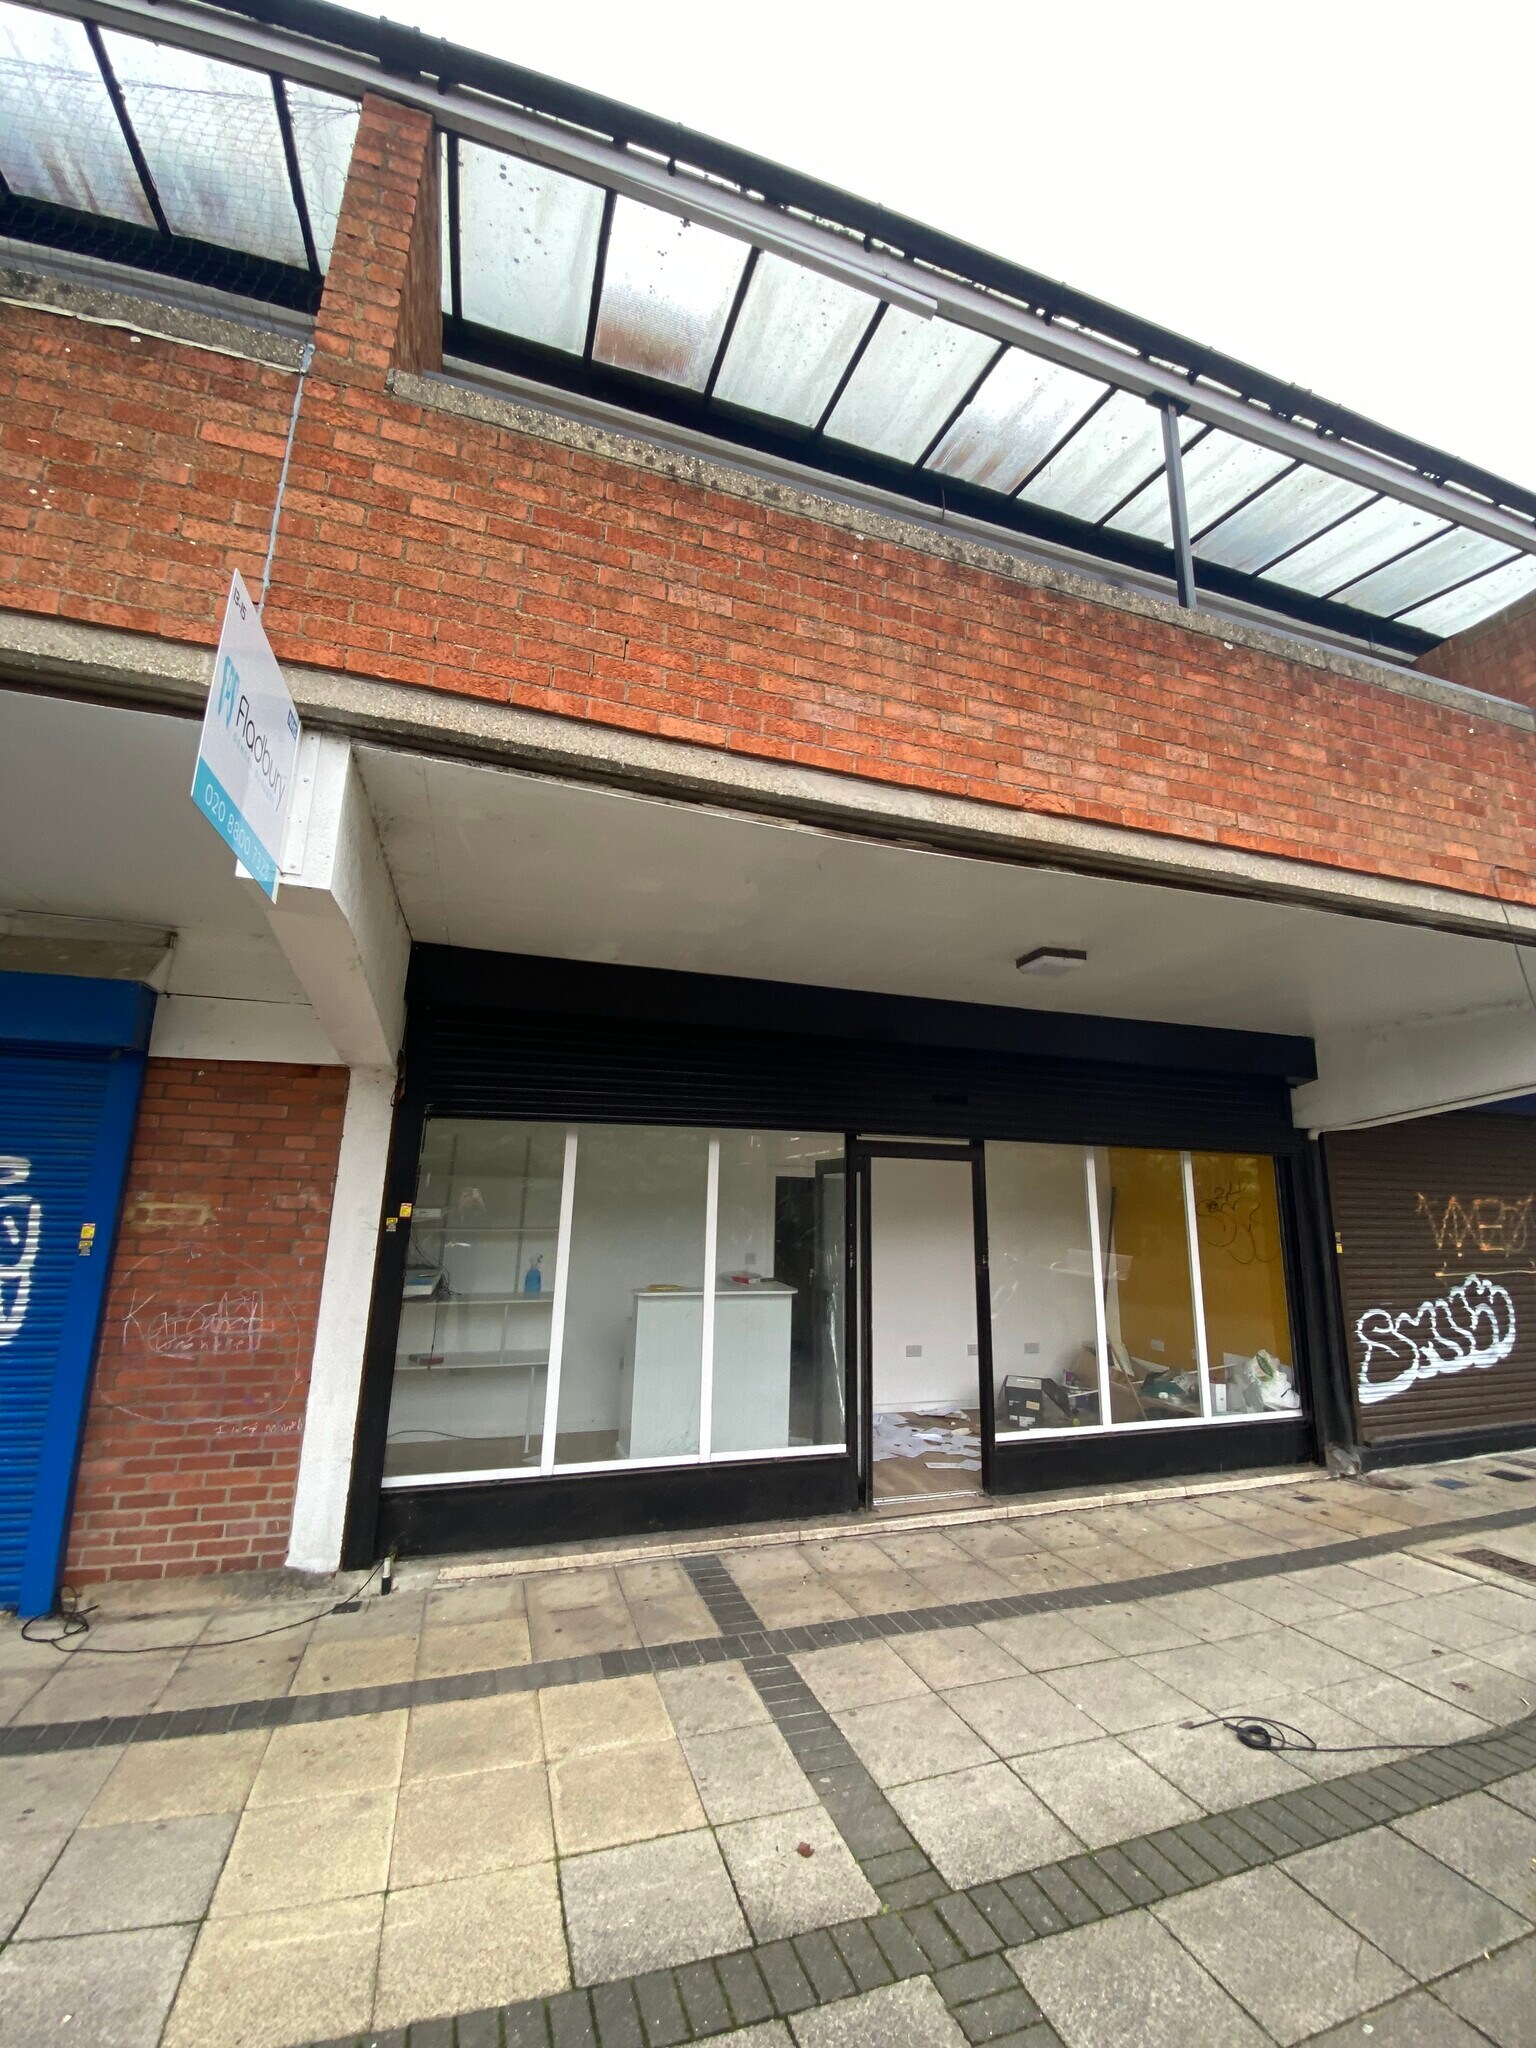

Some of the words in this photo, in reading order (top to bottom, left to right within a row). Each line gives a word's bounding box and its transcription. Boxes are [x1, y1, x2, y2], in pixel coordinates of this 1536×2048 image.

[235, 695, 286, 812] Fladbury
[204, 783, 226, 823] 020
[227, 813, 251, 856] 8800
